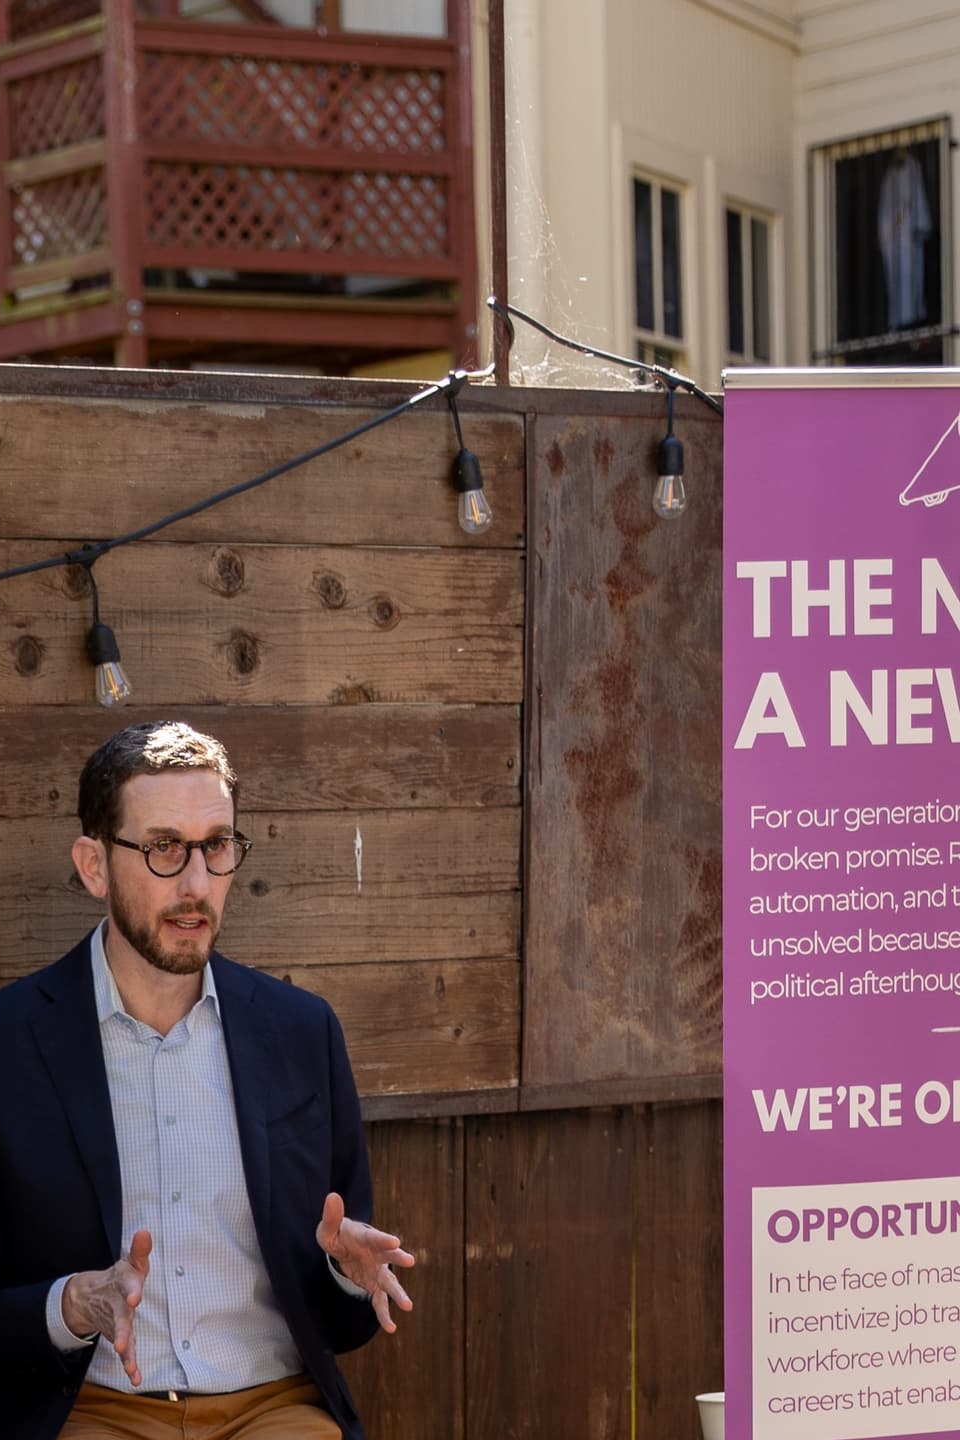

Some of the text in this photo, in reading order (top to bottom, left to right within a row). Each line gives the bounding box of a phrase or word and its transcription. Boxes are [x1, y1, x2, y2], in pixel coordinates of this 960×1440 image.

[737, 558, 893, 638] THE
[734, 672, 806, 749] A
[750, 805, 792, 829] For
[797, 808, 839, 827] our
[750, 846, 839, 872] broken
[846, 842, 943, 875] promise.
[749, 886, 898, 914] automation,
[903, 883, 946, 909] and
[750, 928, 960, 957] unsolved because
[750, 971, 843, 1005] political
[752, 1080, 960, 1132] WE’RE O
[769, 1272, 791, 1293] In
[796, 1270, 837, 1293] the
[841, 1267, 887, 1290] face
[891, 1263, 913, 1286] of
[768, 1303, 960, 1334] incentivize job tra
[768, 1343, 957, 1374] workforce where
[768, 1379, 960, 1413] careers that enab
